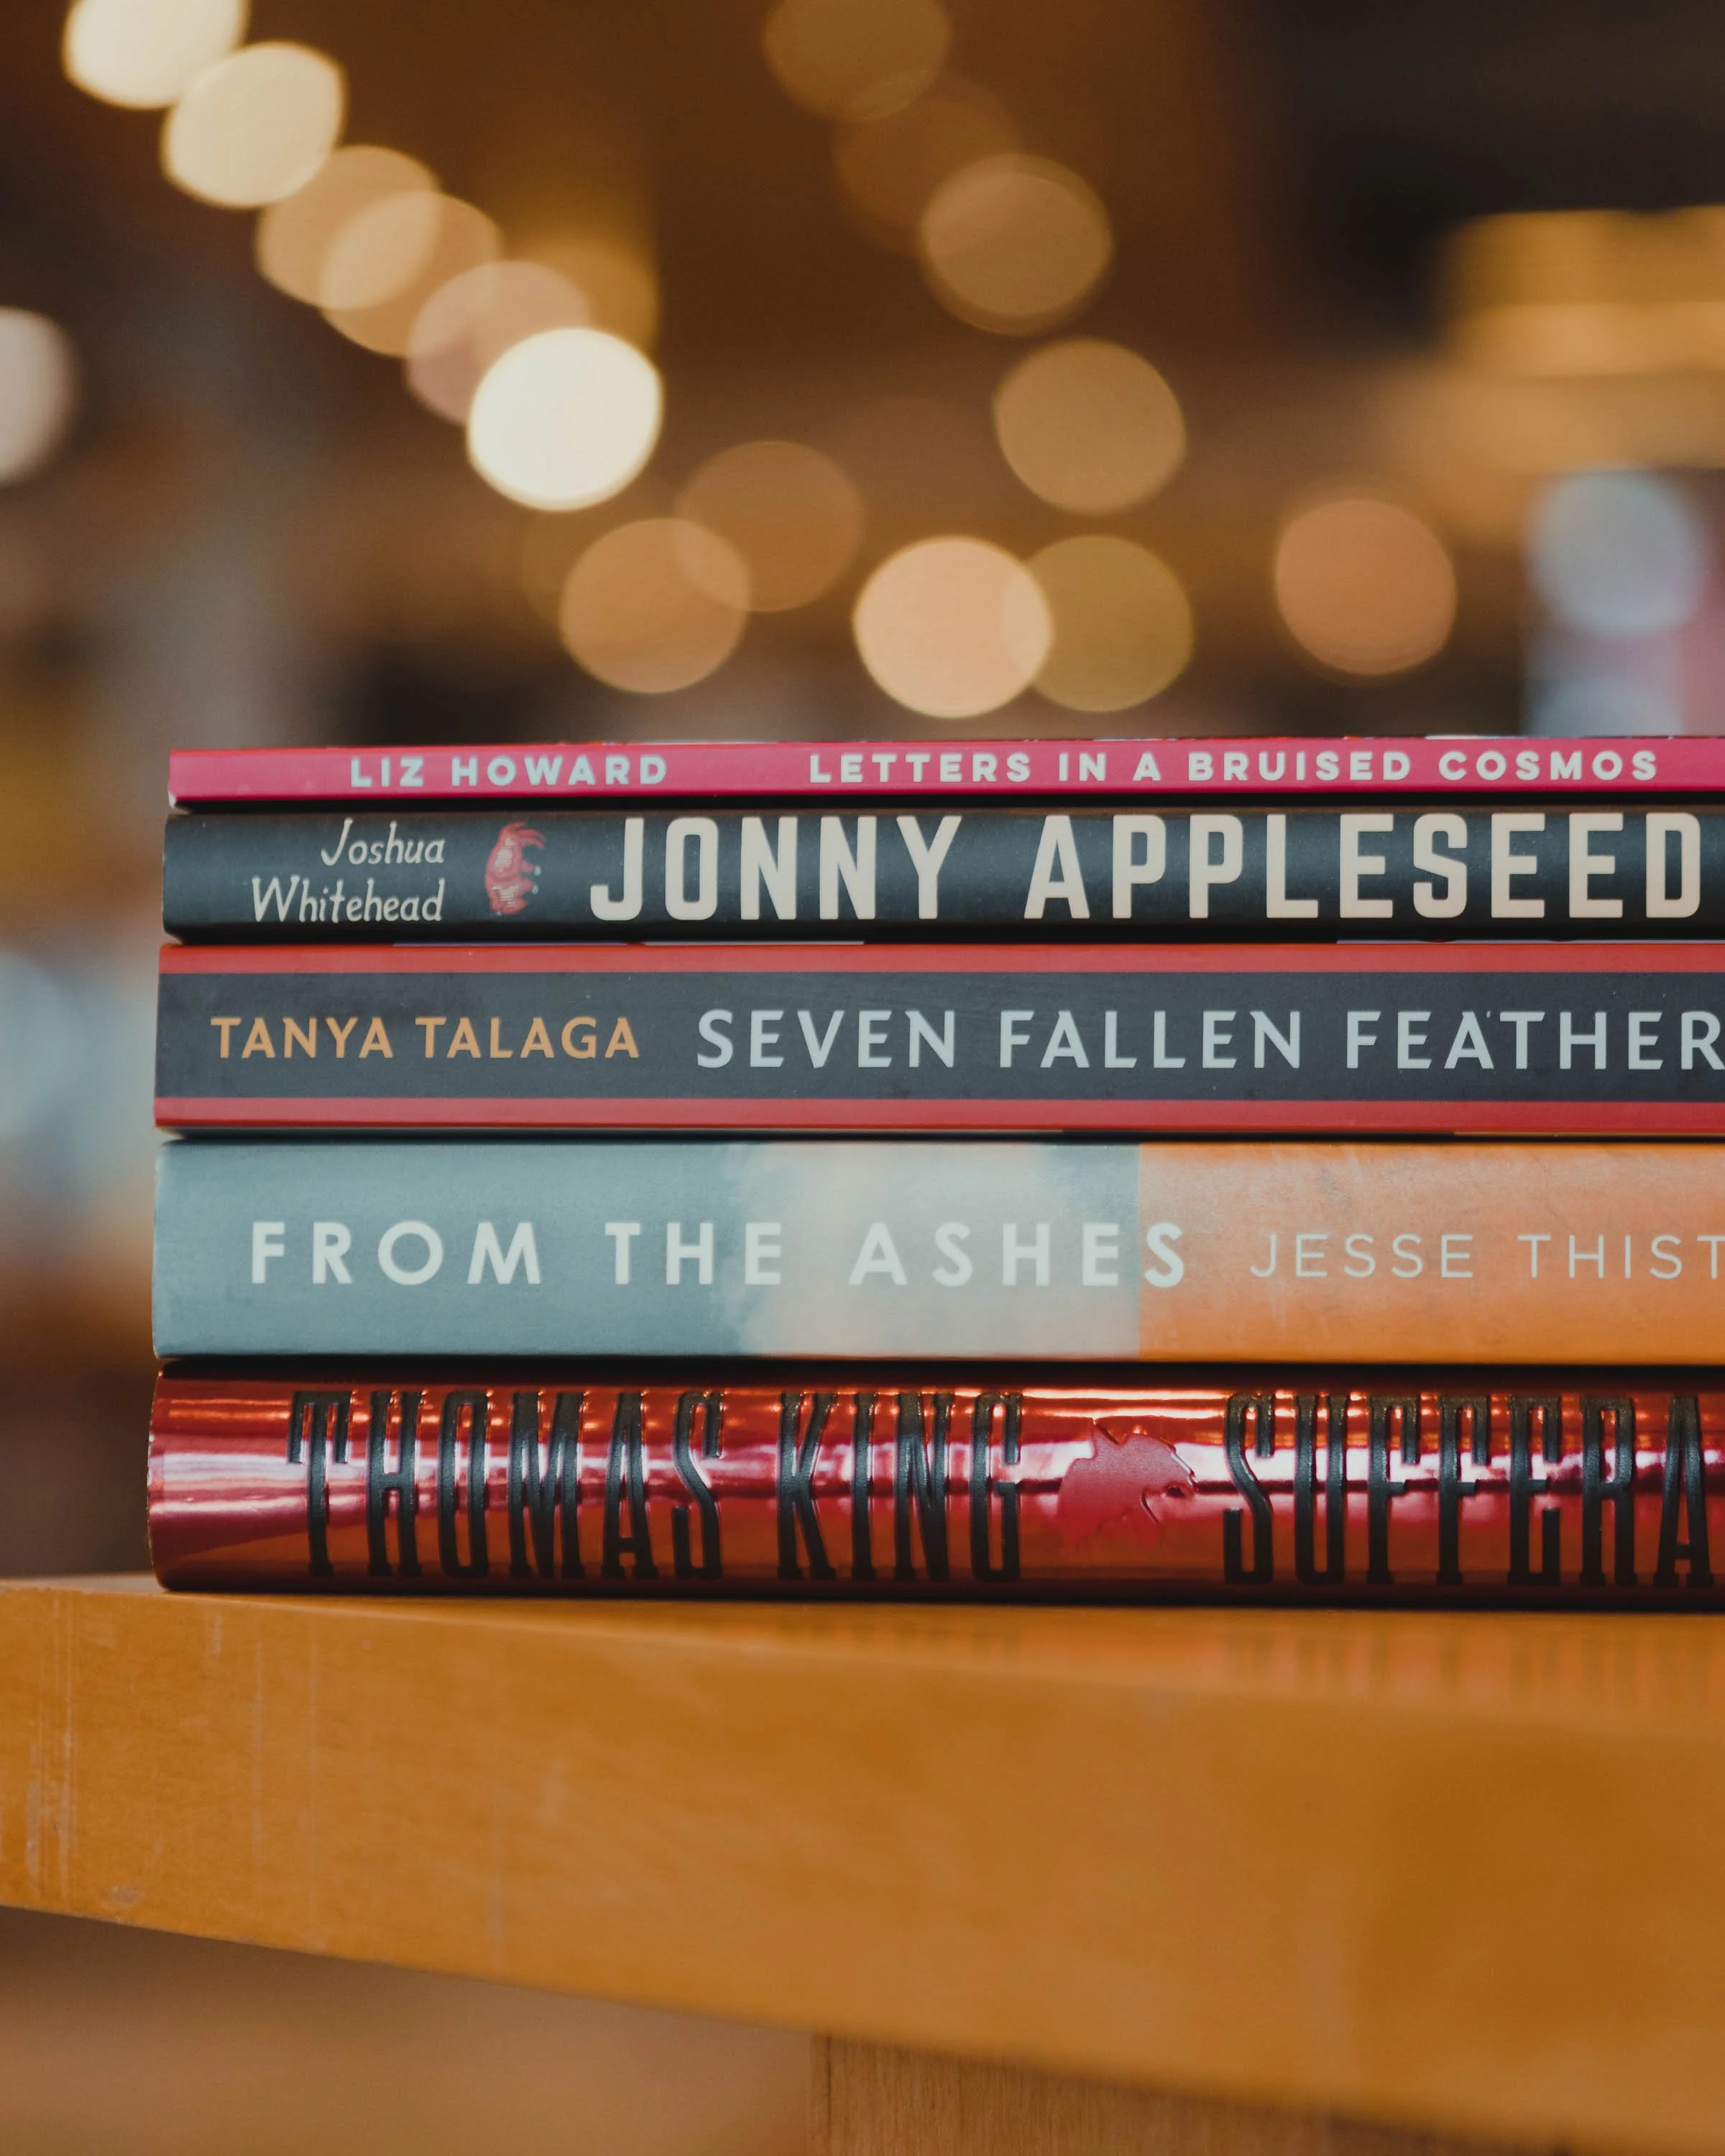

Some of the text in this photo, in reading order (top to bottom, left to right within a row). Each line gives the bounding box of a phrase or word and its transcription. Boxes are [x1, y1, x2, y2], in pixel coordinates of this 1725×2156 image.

[351, 755, 668, 788] LIZ HOWARD
[809, 750, 1657, 783] LETTERS IN A BRUISED COSMOS
[321, 818, 445, 866] Joshua
[590, 813, 1701, 921] JONNY APPLESEED
[252, 874, 445, 923] Whitehead
[210, 1016, 639, 1059] TANYA TALAGA
[696, 1009, 1725, 1070] SEVEN FALLEN FEATHER
[252, 1220, 1184, 1287] FROM THE ASHES
[1250, 1233, 1725, 1279] JESSE THIST
[288, 1390, 1022, 1580] THOMAS KING
[1224, 1393, 1713, 1585] SUFFERA
